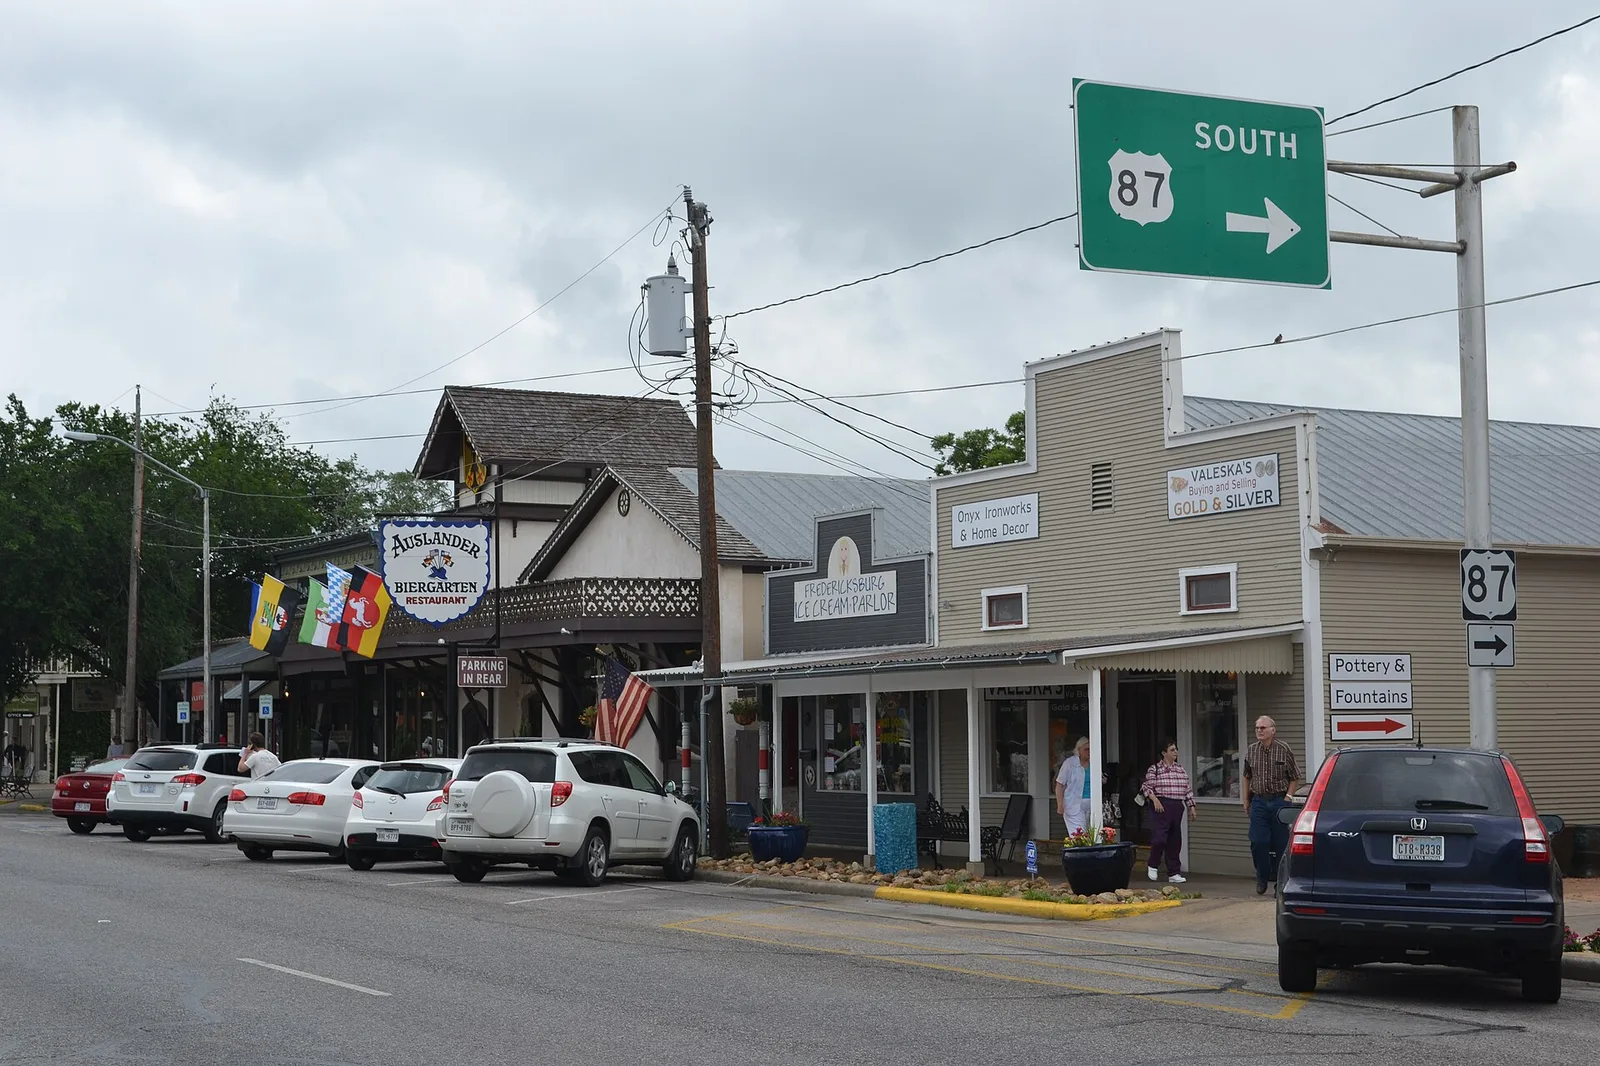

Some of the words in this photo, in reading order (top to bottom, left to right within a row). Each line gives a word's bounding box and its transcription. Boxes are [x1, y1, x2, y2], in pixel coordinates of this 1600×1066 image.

[1195, 122, 1297, 159] SOUTH
[1117, 169, 1165, 208] 87
[1191, 461, 1252, 482] VALESKA'S
[1189, 485, 1213, 496] Buying
[1216, 481, 1229, 492] and
[1233, 478, 1256, 489] Selling
[957, 510, 980, 523] Onyx
[985, 501, 1032, 519] Ironworks
[1174, 499, 1208, 516] GOLD
[1212, 497, 1222, 511] &
[1226, 489, 1273, 509] SILVER
[960, 529, 967, 541] &
[972, 527, 997, 540] Home
[1002, 523, 1029, 536] Decor
[391, 532, 481, 559] AUSLANDER
[394, 581, 478, 593] BIERGARTEN
[804, 575, 885, 598] FREDERICKSBURG
[1467, 564, 1510, 603] 87
[405, 596, 468, 605] RESTAURANT
[794, 600, 810, 619] ICE
[813, 596, 849, 617] CREAM
[852, 592, 895, 614] PARLOR
[461, 660, 505, 672] PARKING
[1335, 658, 1391, 675] Pottery
[1394, 658, 1405, 673] &
[463, 673, 474, 684] IN
[476, 673, 502, 684] REAR
[1335, 688, 1408, 704] Fountains
